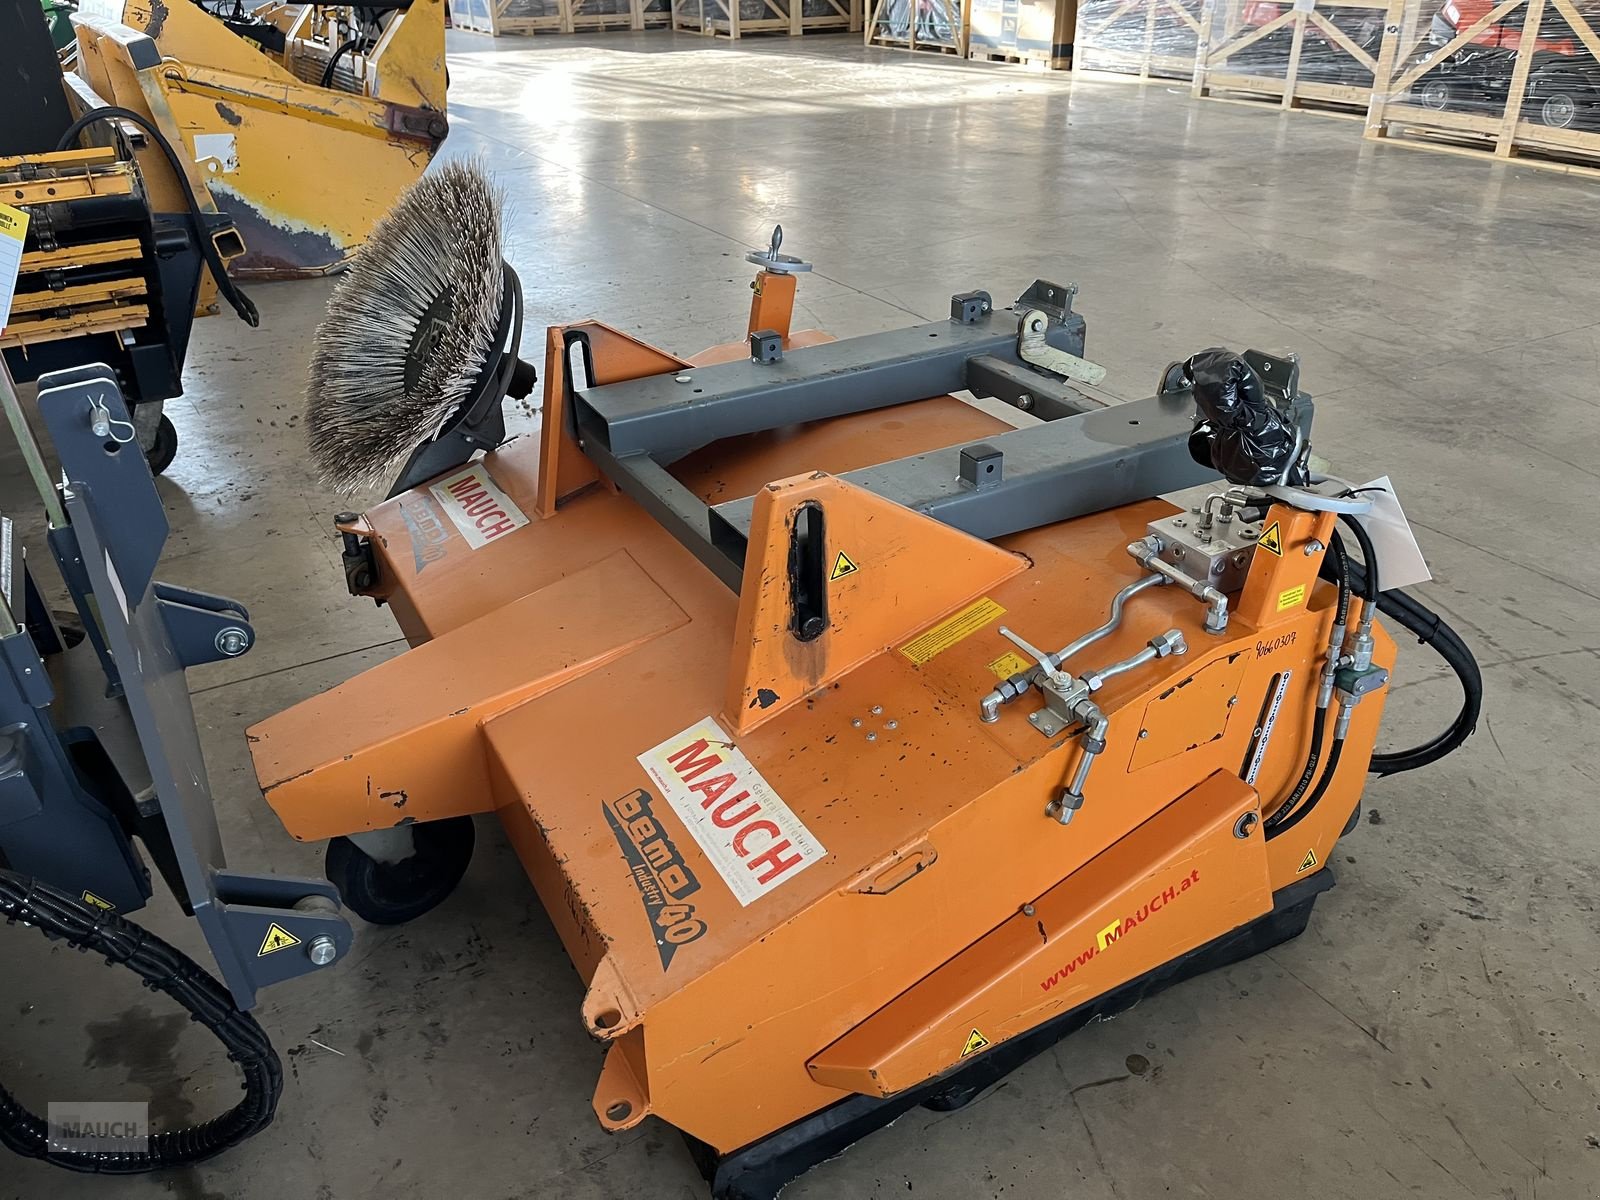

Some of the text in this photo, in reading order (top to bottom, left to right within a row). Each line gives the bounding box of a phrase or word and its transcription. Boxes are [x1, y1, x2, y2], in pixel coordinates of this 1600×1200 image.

[447, 475, 515, 540] MAUCH
[613, 788, 701, 900] bemo
[666, 738, 804, 886] MAUCH
[631, 863, 664, 906] Industry
[656, 904, 708, 945] 40
[1040, 869, 1200, 992] www.MAUCH.at
